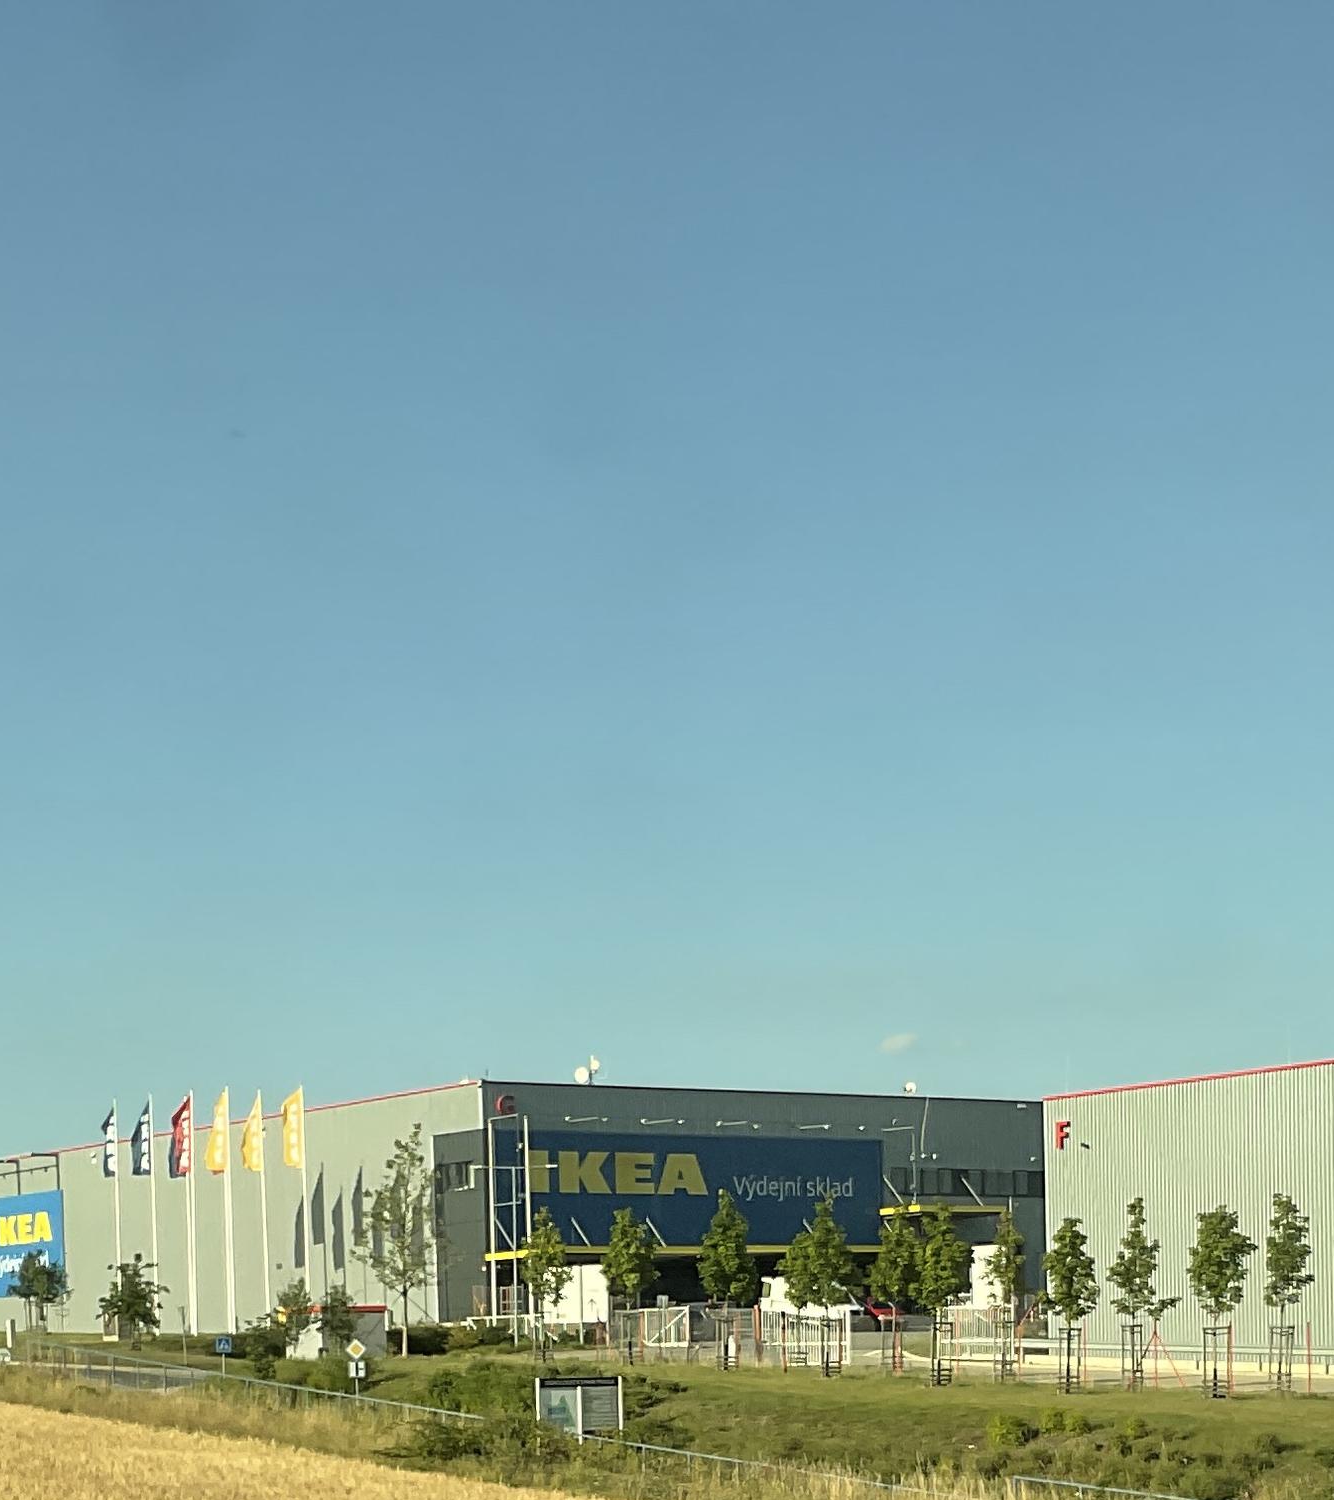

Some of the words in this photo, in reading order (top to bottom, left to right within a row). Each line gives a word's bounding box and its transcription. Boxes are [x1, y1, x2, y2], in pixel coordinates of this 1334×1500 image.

[1055, 1121, 1071, 1151] F
[527, 1149, 709, 1196] IKEA
[732, 1174, 802, 1202] Výdejní
[806, 1175, 854, 1198] sklad
